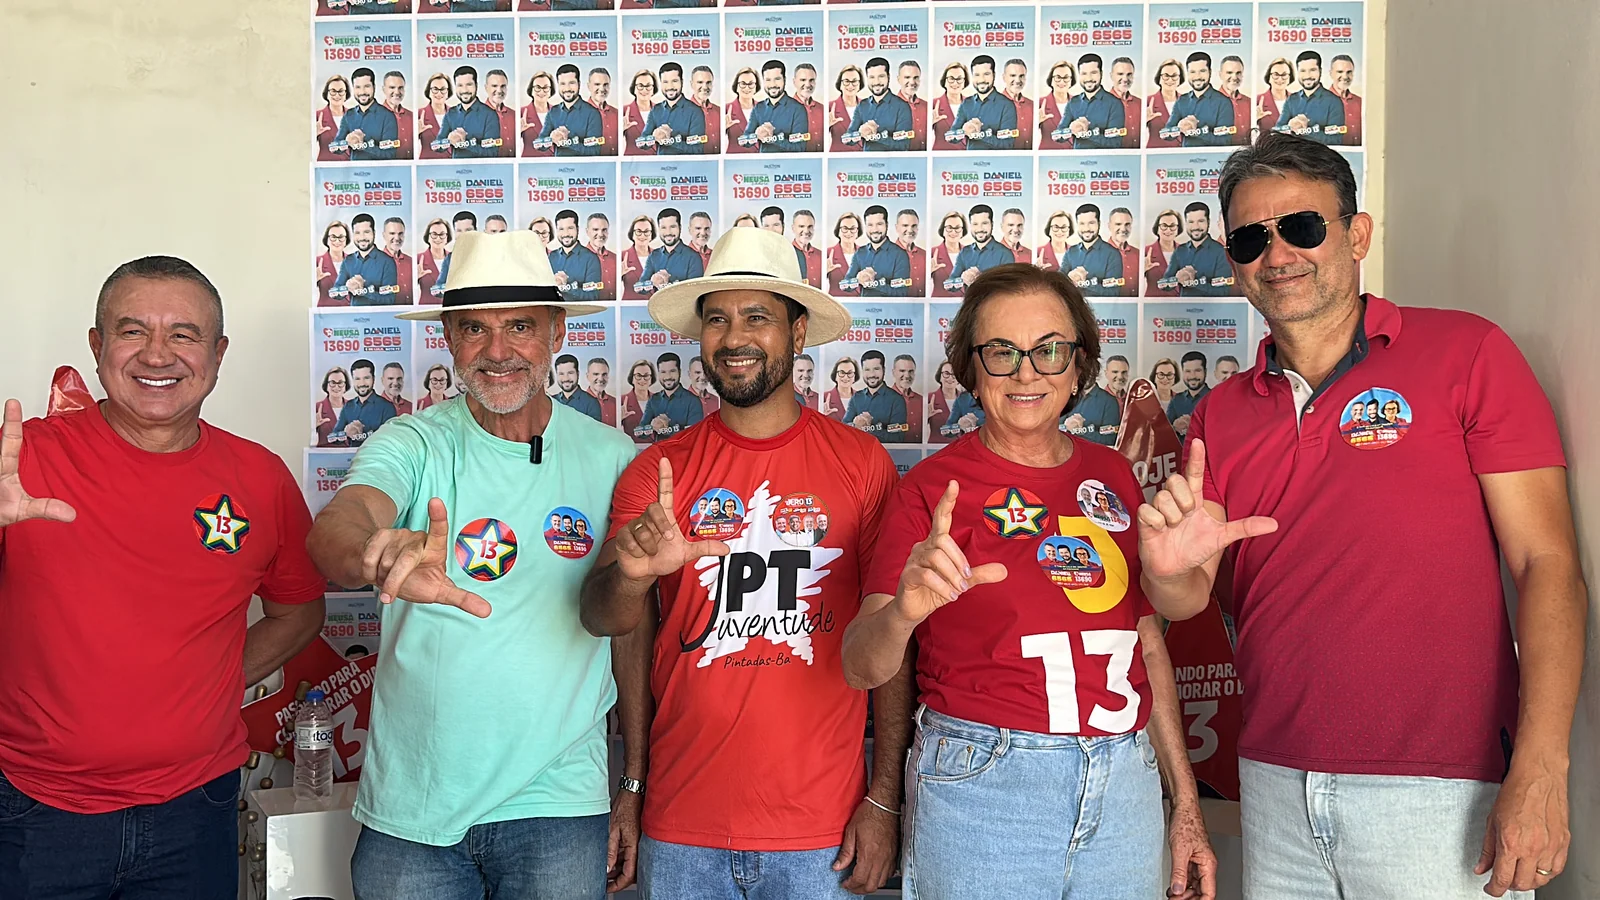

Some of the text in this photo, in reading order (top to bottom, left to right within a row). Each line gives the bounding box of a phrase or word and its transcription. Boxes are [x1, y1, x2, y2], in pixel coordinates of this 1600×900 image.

[879, 33, 918, 44] 6565
[985, 31, 1024, 42] 6565
[1049, 32, 1088, 46] 13690
[1092, 29, 1132, 40] 6565
[1157, 30, 1197, 44] 13690
[1201, 28, 1241, 39] 6565
[1267, 29, 1307, 43] 13690
[1311, 27, 1352, 38] 6565
[569, 41, 607, 51] 6565
[672, 39, 710, 49] 6565
[734, 39, 771, 53] 13690
[775, 36, 813, 47] 6565
[837, 36, 875, 50] 13690
[943, 34, 981, 47] 13690
[324, 47, 360, 60] 13690
[364, 44, 402, 55] 6565
[426, 45, 463, 58] 13690
[467, 42, 504, 53] 6565
[528, 43, 566, 56] 13690
[631, 42, 669, 55] 13690
[568, 187, 606, 197] 6565
[671, 185, 708, 196] 6565
[774, 183, 812, 194] 6565
[836, 184, 874, 197] 13690
[878, 182, 916, 193] 6565
[941, 183, 979, 197] 13690
[983, 181, 1022, 192] 6565
[1047, 182, 1086, 196] 13690
[1090, 180, 1130, 191] 6565
[1155, 181, 1195, 194] 13690
[364, 190, 402, 201] 6565
[425, 191, 462, 204] 13690
[465, 188, 504, 199] 6565
[527, 189, 565, 202] 13690
[629, 187, 667, 201] 13690
[732, 186, 770, 199] 13690
[324, 193, 360, 206] 13690
[568, 331, 605, 342] 6565
[629, 332, 666, 345] 13690
[875, 327, 913, 338] 6565
[1152, 330, 1192, 343] 13690
[1196, 328, 1236, 339] 6565
[323, 339, 360, 352] 13690
[363, 336, 401, 347] 6565
[1132, 452, 1177, 487] OJE
[1007, 507, 1028, 523] 13
[216, 514, 232, 534] 13
[480, 540, 498, 560] 13
[726, 550, 811, 613] PT
[680, 555, 836, 652] Juventude
[724, 652, 791, 669] Pintadas-Ba
[329, 662, 360, 690] PARA
[1020, 630, 1141, 734] 13
[350, 680, 362, 694] O
[1224, 681, 1234, 696] O
